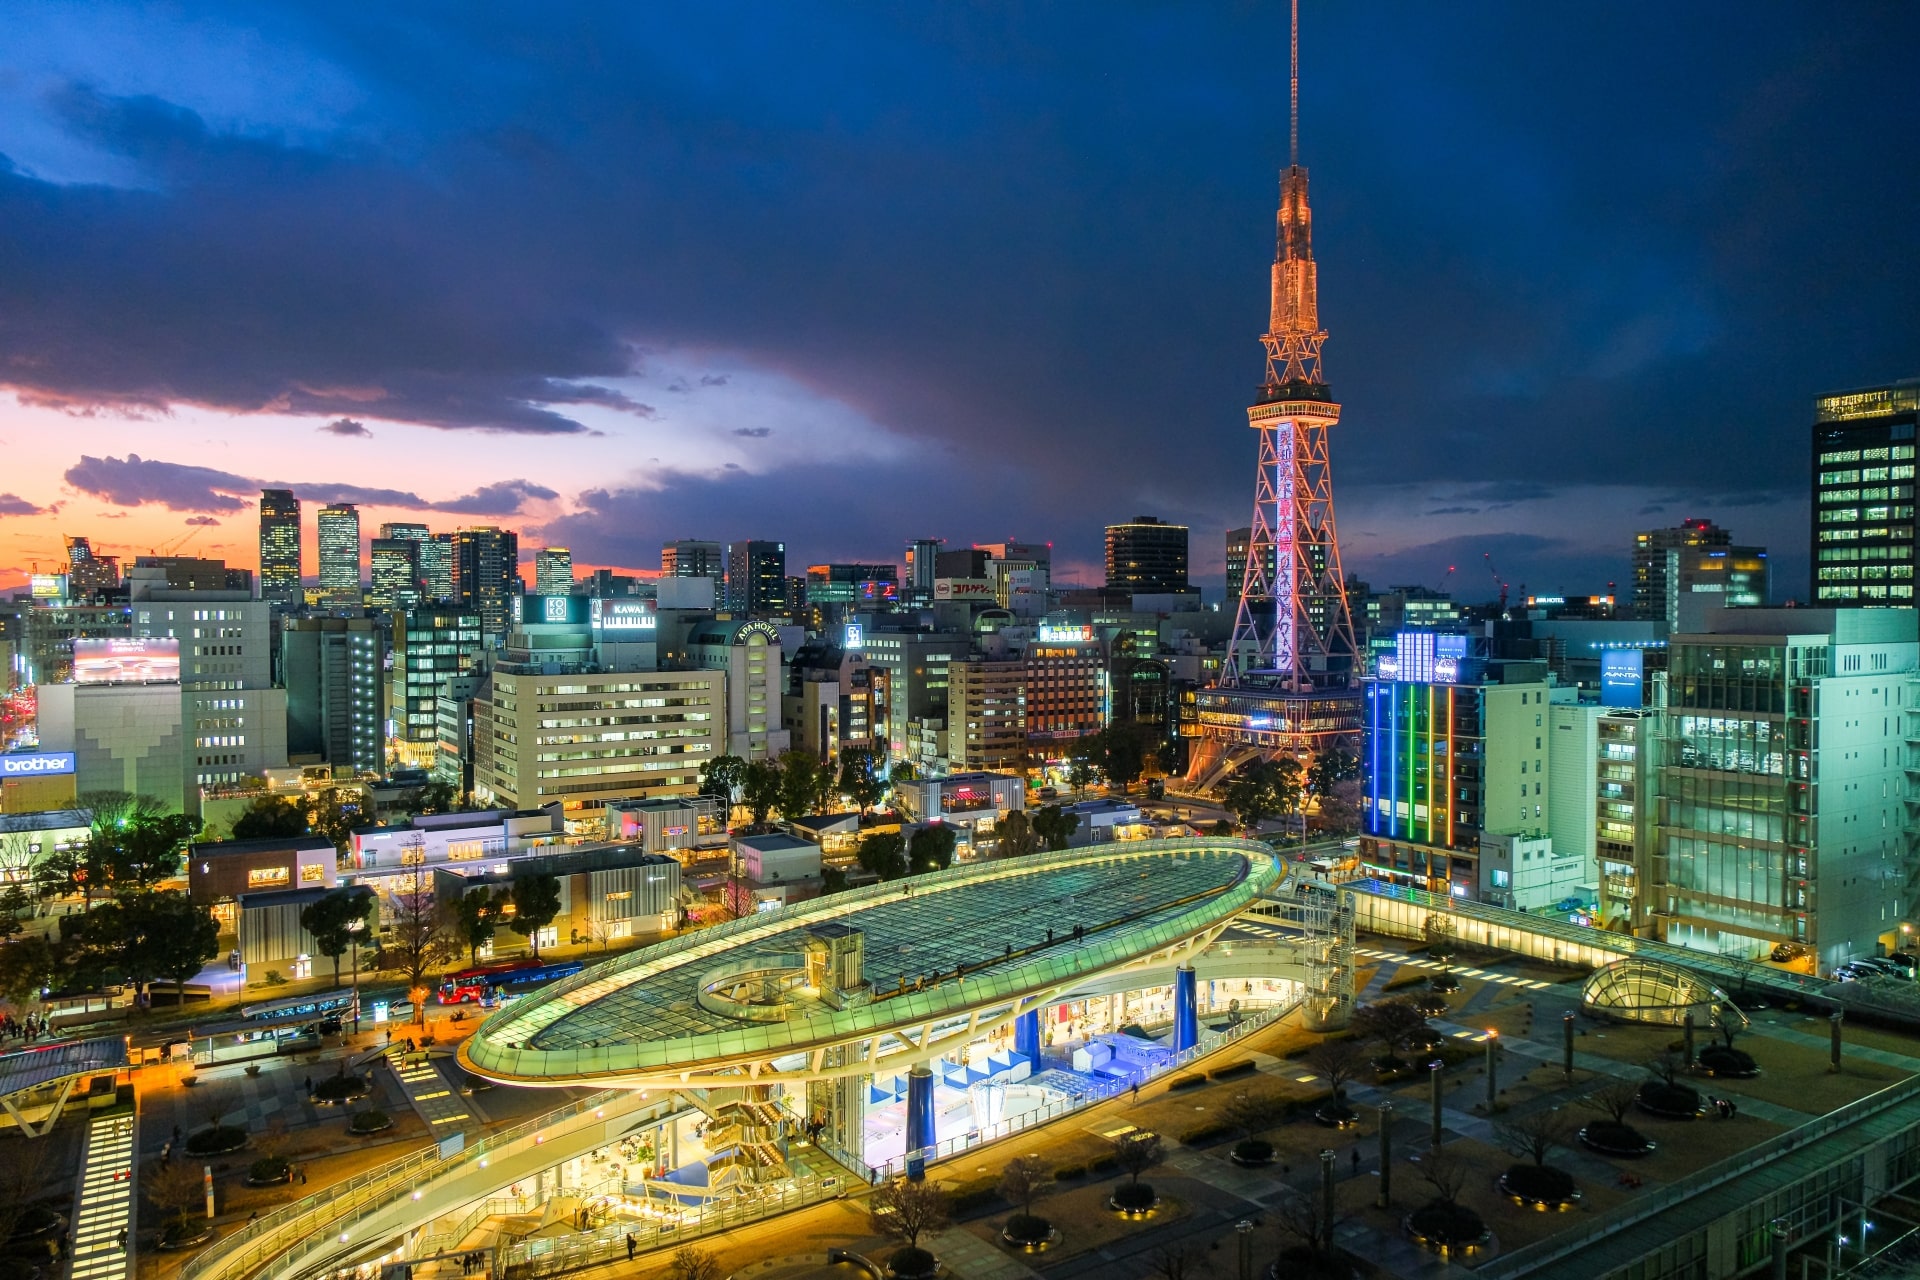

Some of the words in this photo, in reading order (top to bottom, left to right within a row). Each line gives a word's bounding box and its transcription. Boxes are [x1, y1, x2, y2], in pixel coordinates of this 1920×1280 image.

[614, 605, 645, 614] KAWAI
[738, 624, 754, 640] APA
[754, 622, 778, 641] HOTEL
[4, 757, 68, 772] brother
